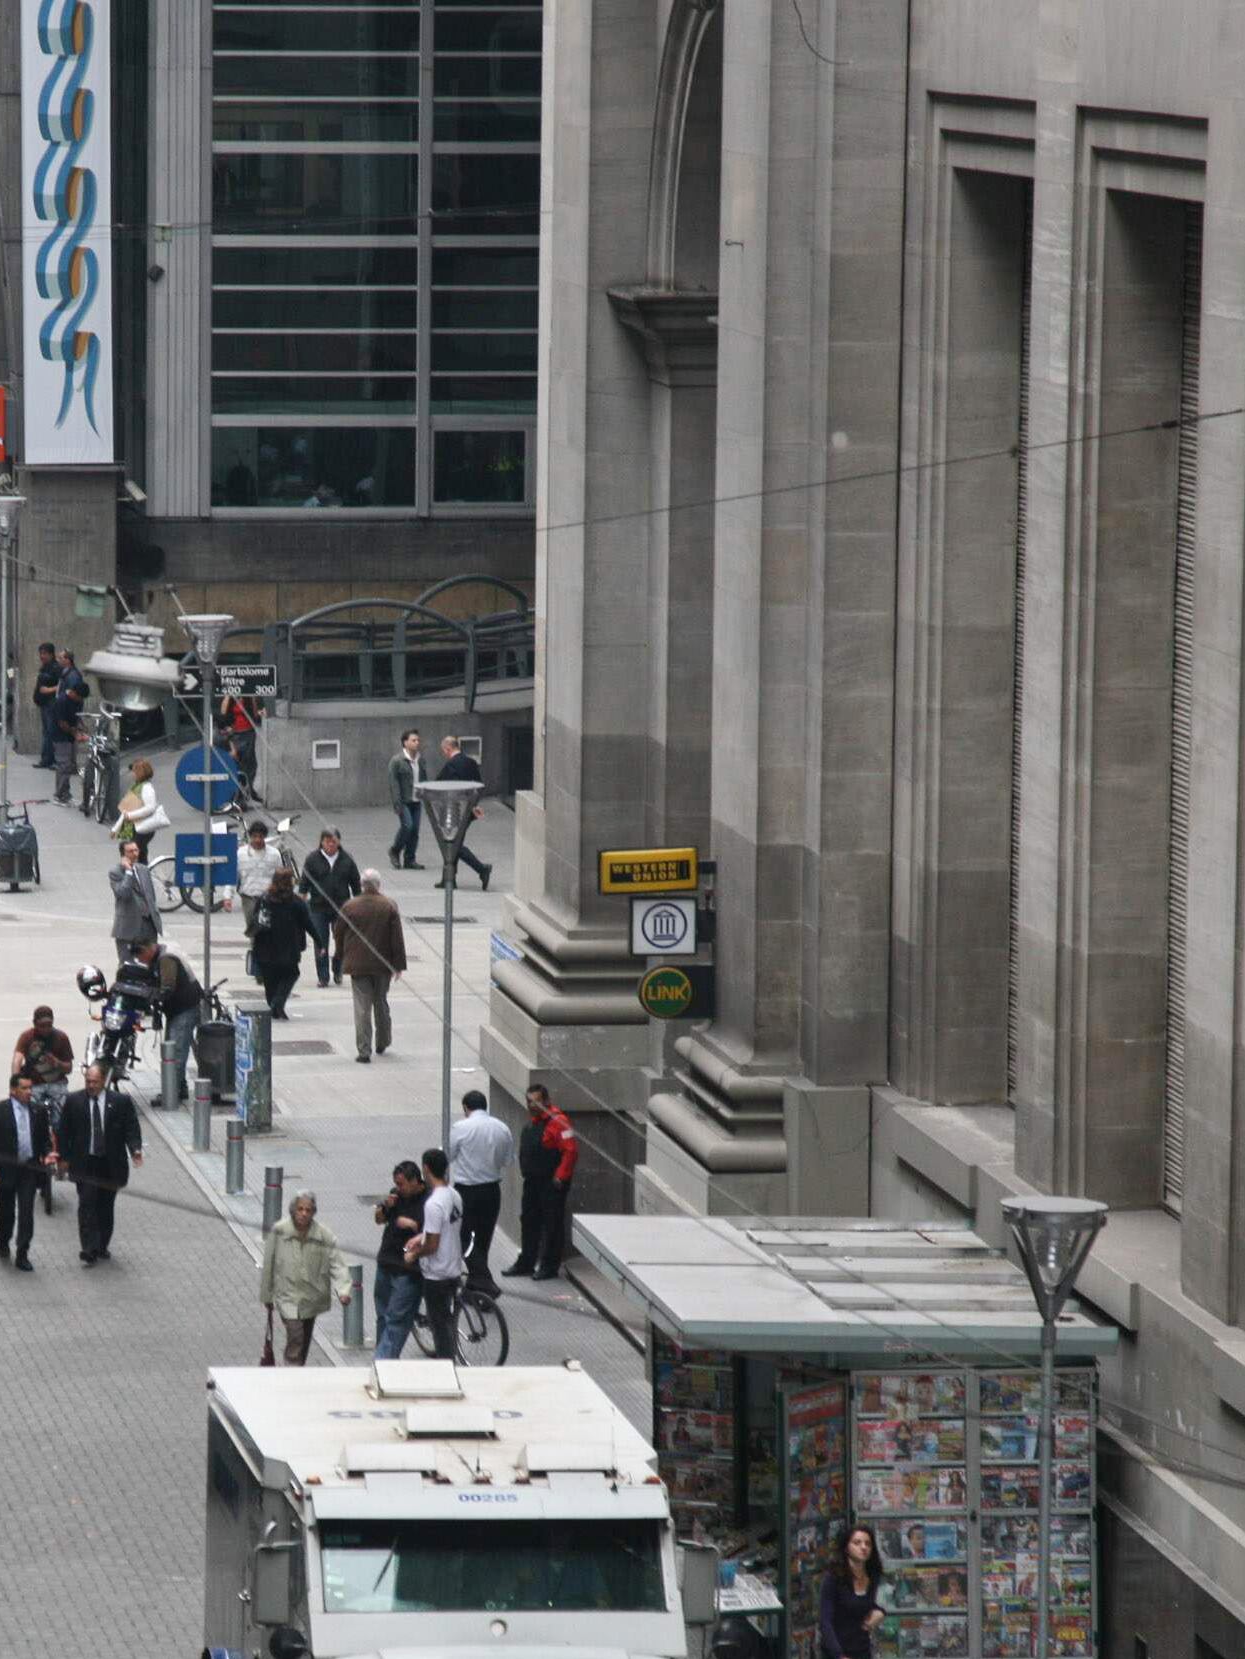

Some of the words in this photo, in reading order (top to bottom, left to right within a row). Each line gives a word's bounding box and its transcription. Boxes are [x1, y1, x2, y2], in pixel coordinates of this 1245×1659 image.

[221, 677, 245, 686] Mitre
[255, 685, 275, 695] 300
[611, 862, 677, 874] WESTERN
[633, 871, 677, 882] UNION
[458, 1493, 518, 1502] 00285
